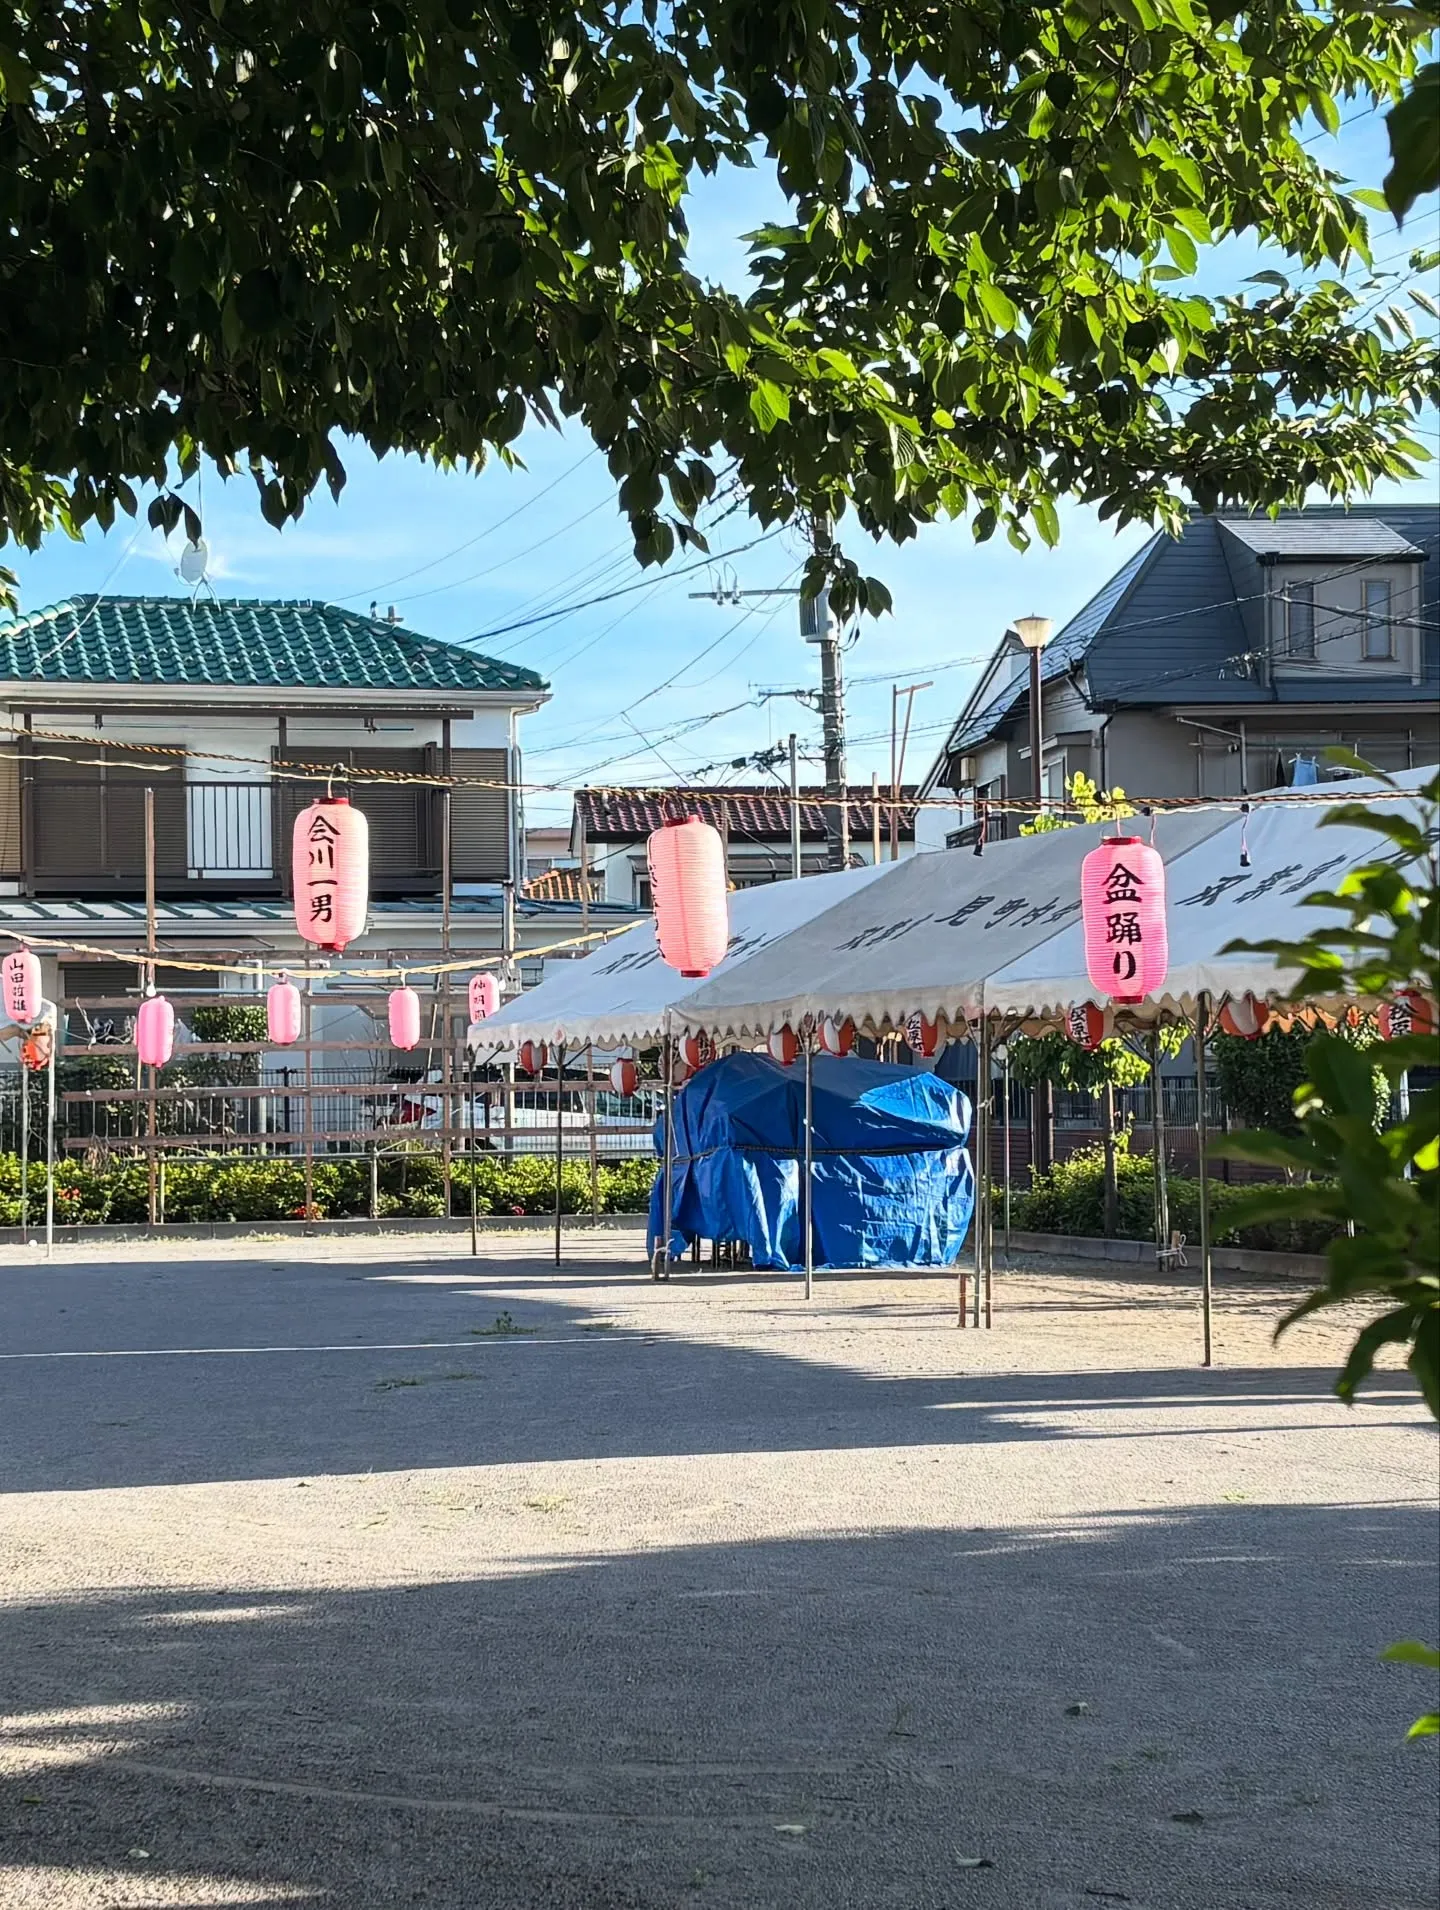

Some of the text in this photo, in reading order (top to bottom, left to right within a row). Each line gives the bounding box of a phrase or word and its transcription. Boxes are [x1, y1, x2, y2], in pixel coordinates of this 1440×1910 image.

[306, 814, 341, 923] 会川一男
[1101, 862, 1145, 981] 盆踊り
